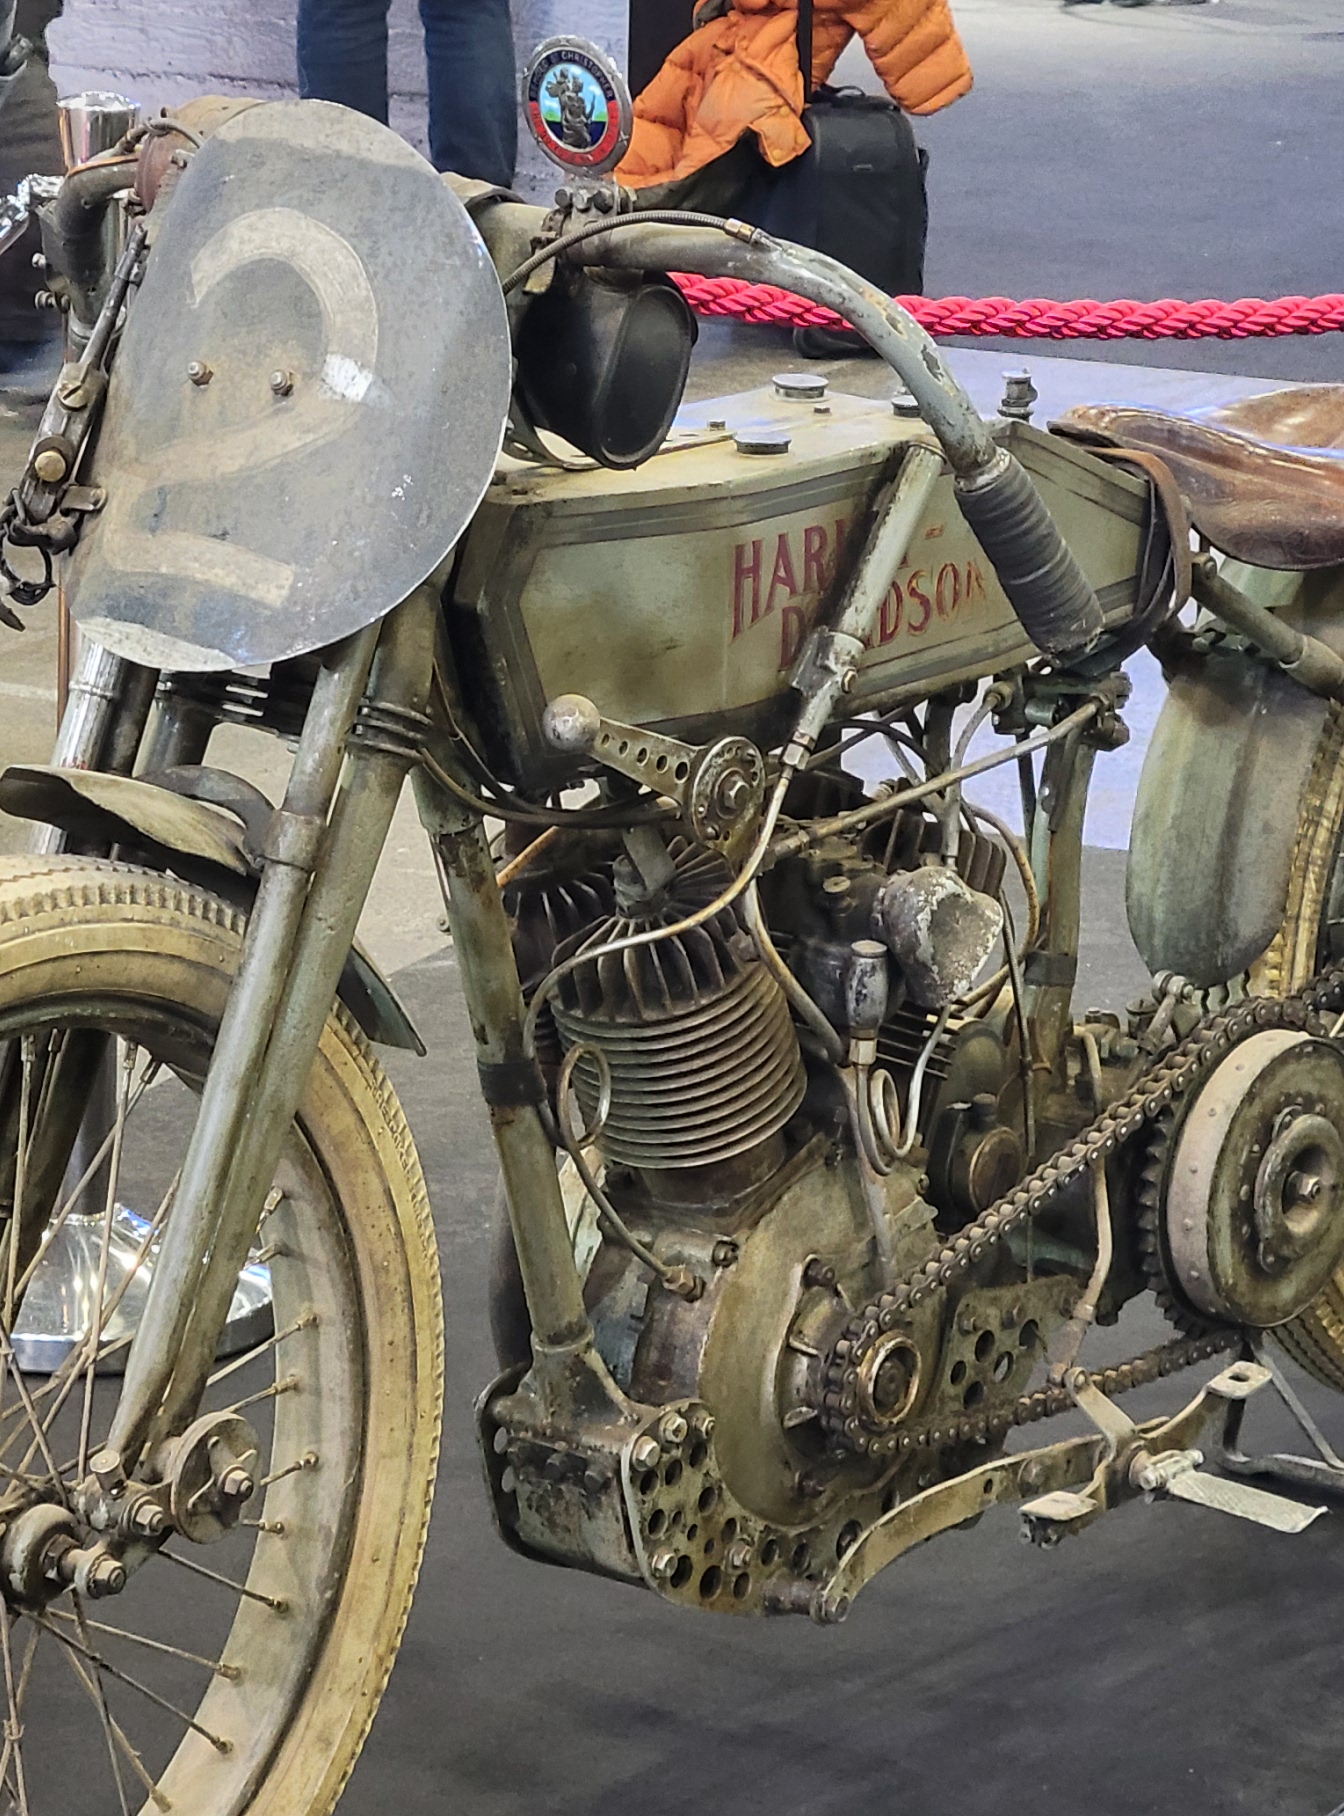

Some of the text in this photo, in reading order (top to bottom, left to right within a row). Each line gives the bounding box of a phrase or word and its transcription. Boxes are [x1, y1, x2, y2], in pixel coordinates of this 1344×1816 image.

[561, 51, 615, 99] CHRISTOPHER
[105, 207, 378, 608] 2
[777, 560, 986, 672] DDSON
